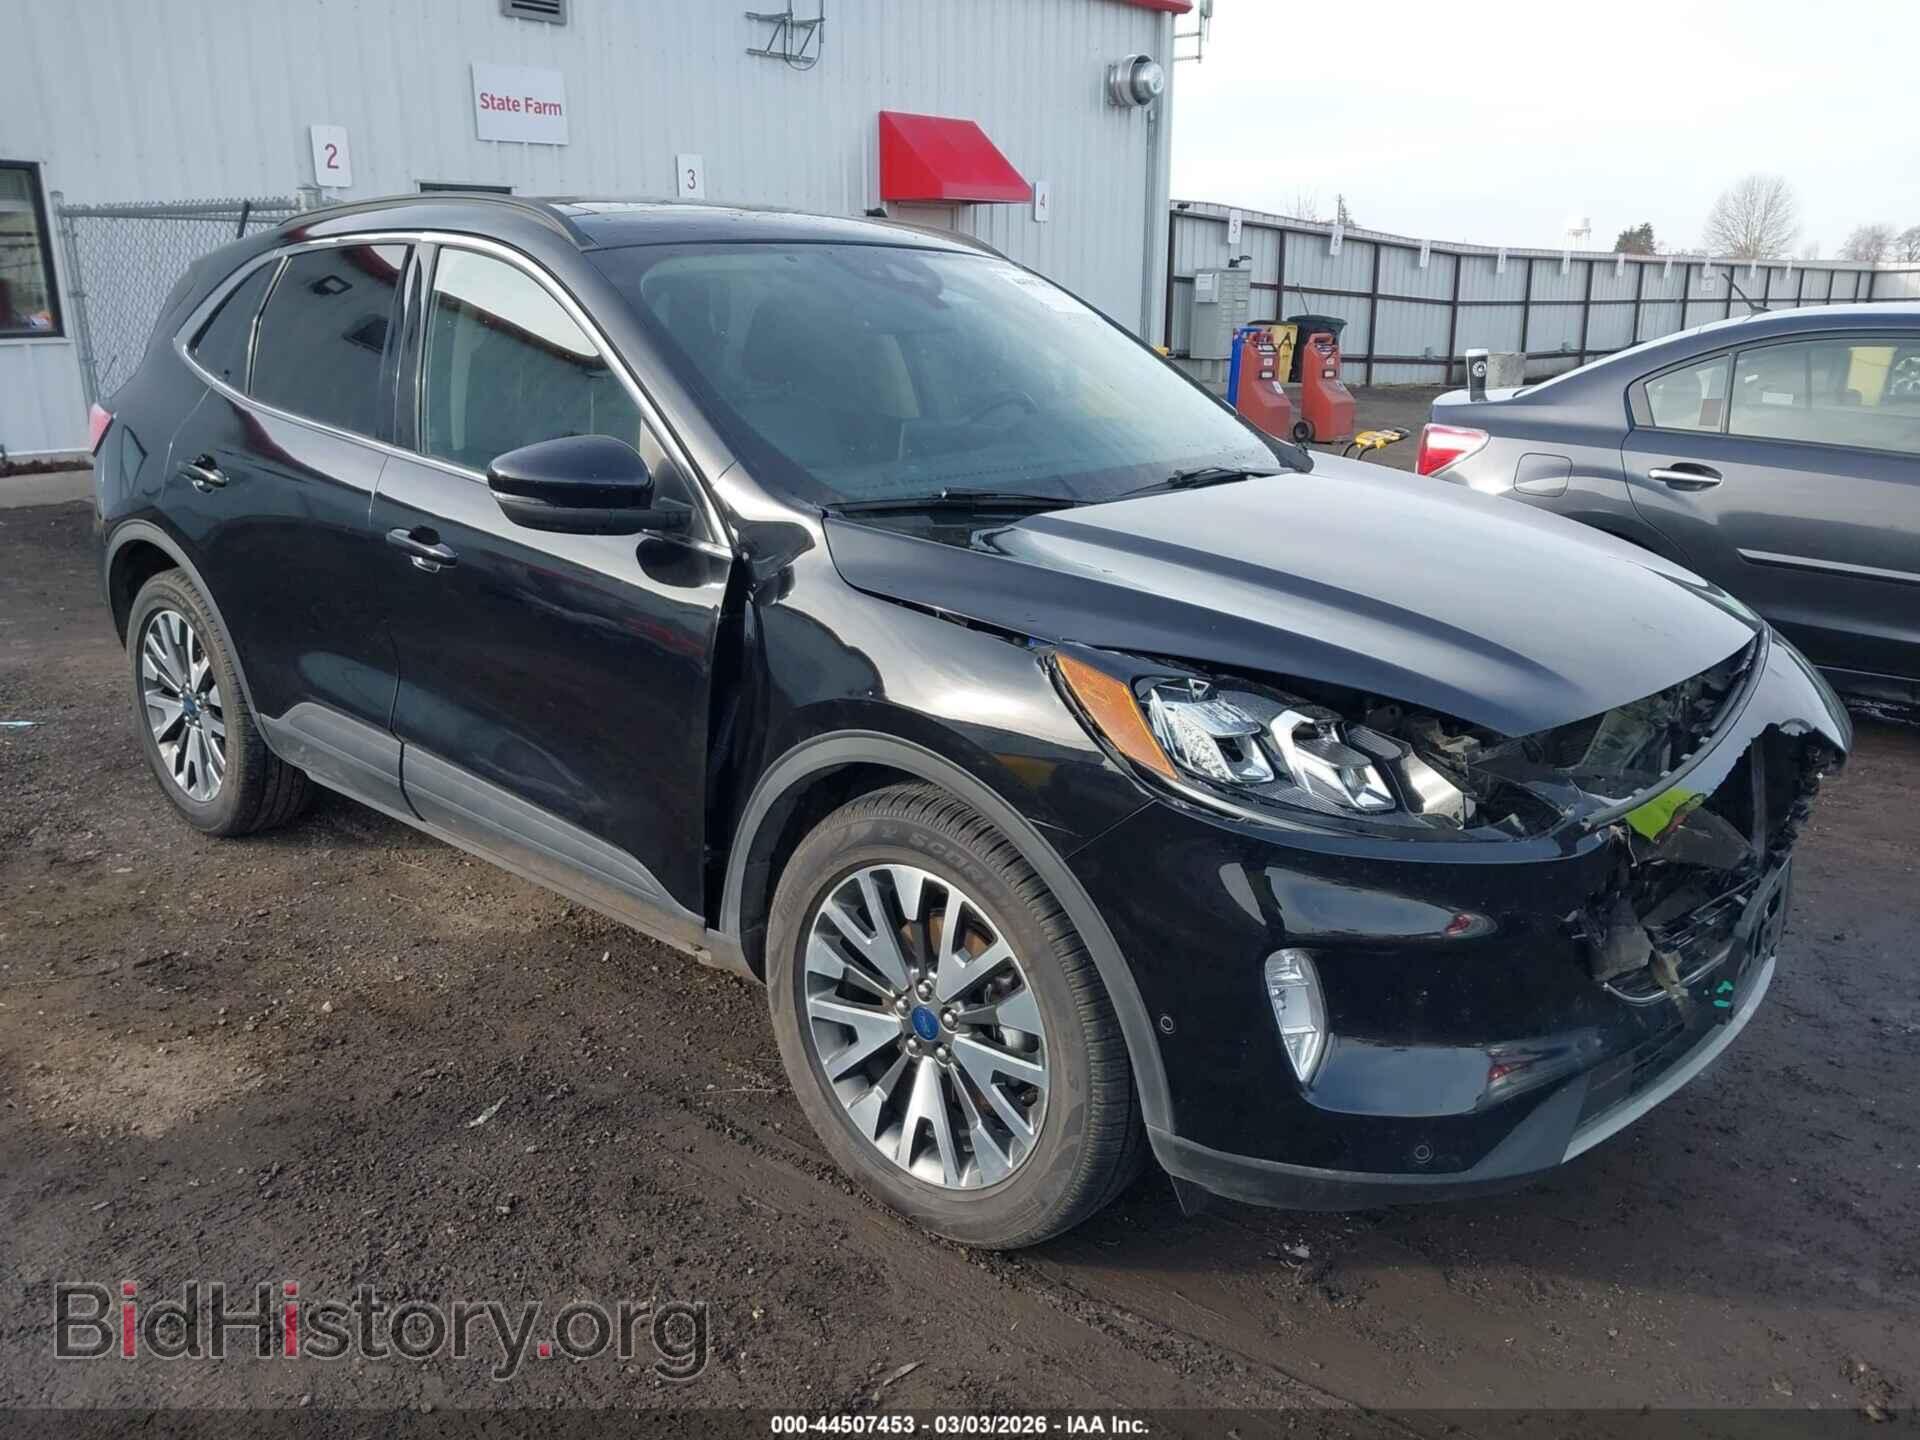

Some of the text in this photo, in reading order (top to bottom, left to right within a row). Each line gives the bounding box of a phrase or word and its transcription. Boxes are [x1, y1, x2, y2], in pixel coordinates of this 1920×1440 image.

[479, 92, 563, 117] State Farm
[324, 143, 340, 169] 2
[687, 168, 697, 190] 3
[1039, 192, 1047, 209] 4
[1231, 218, 1239, 234] 5
